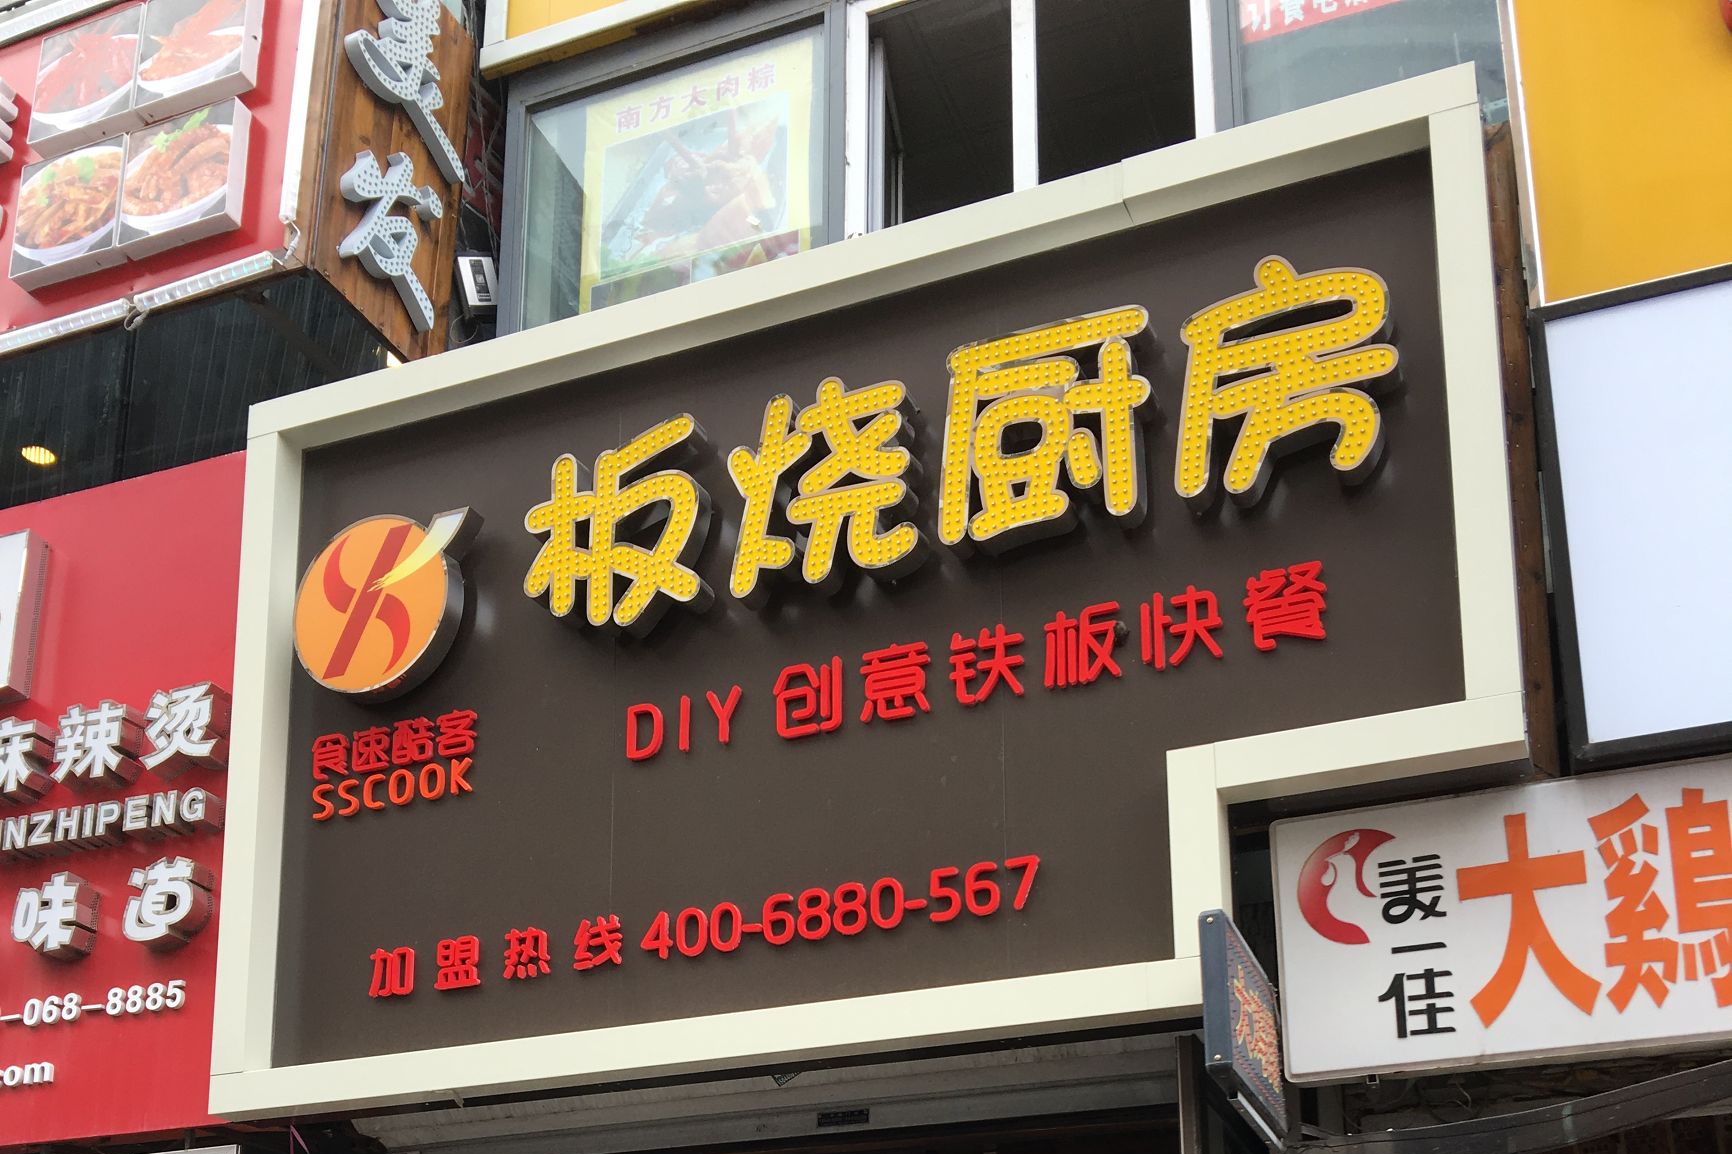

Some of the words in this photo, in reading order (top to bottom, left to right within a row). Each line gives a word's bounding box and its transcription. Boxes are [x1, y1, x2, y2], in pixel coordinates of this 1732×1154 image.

[615, 62, 776, 134] 南方大肉粽
[523, 255, 1400, 628] 板烧厨房
[626, 684, 744, 761] DIY
[773, 559, 1328, 739] 创意铁板快餐
[312, 709, 478, 782] 食速酷客
[0, 787, 208, 852] NZHIPENG
[312, 757, 473, 821] SSCOOK
[11, 856, 194, 952] 味道
[367, 917, 623, 999] 加盟热线
[640, 854, 1042, 960] 400-6880-567
[0, 1062, 55, 1087] om
